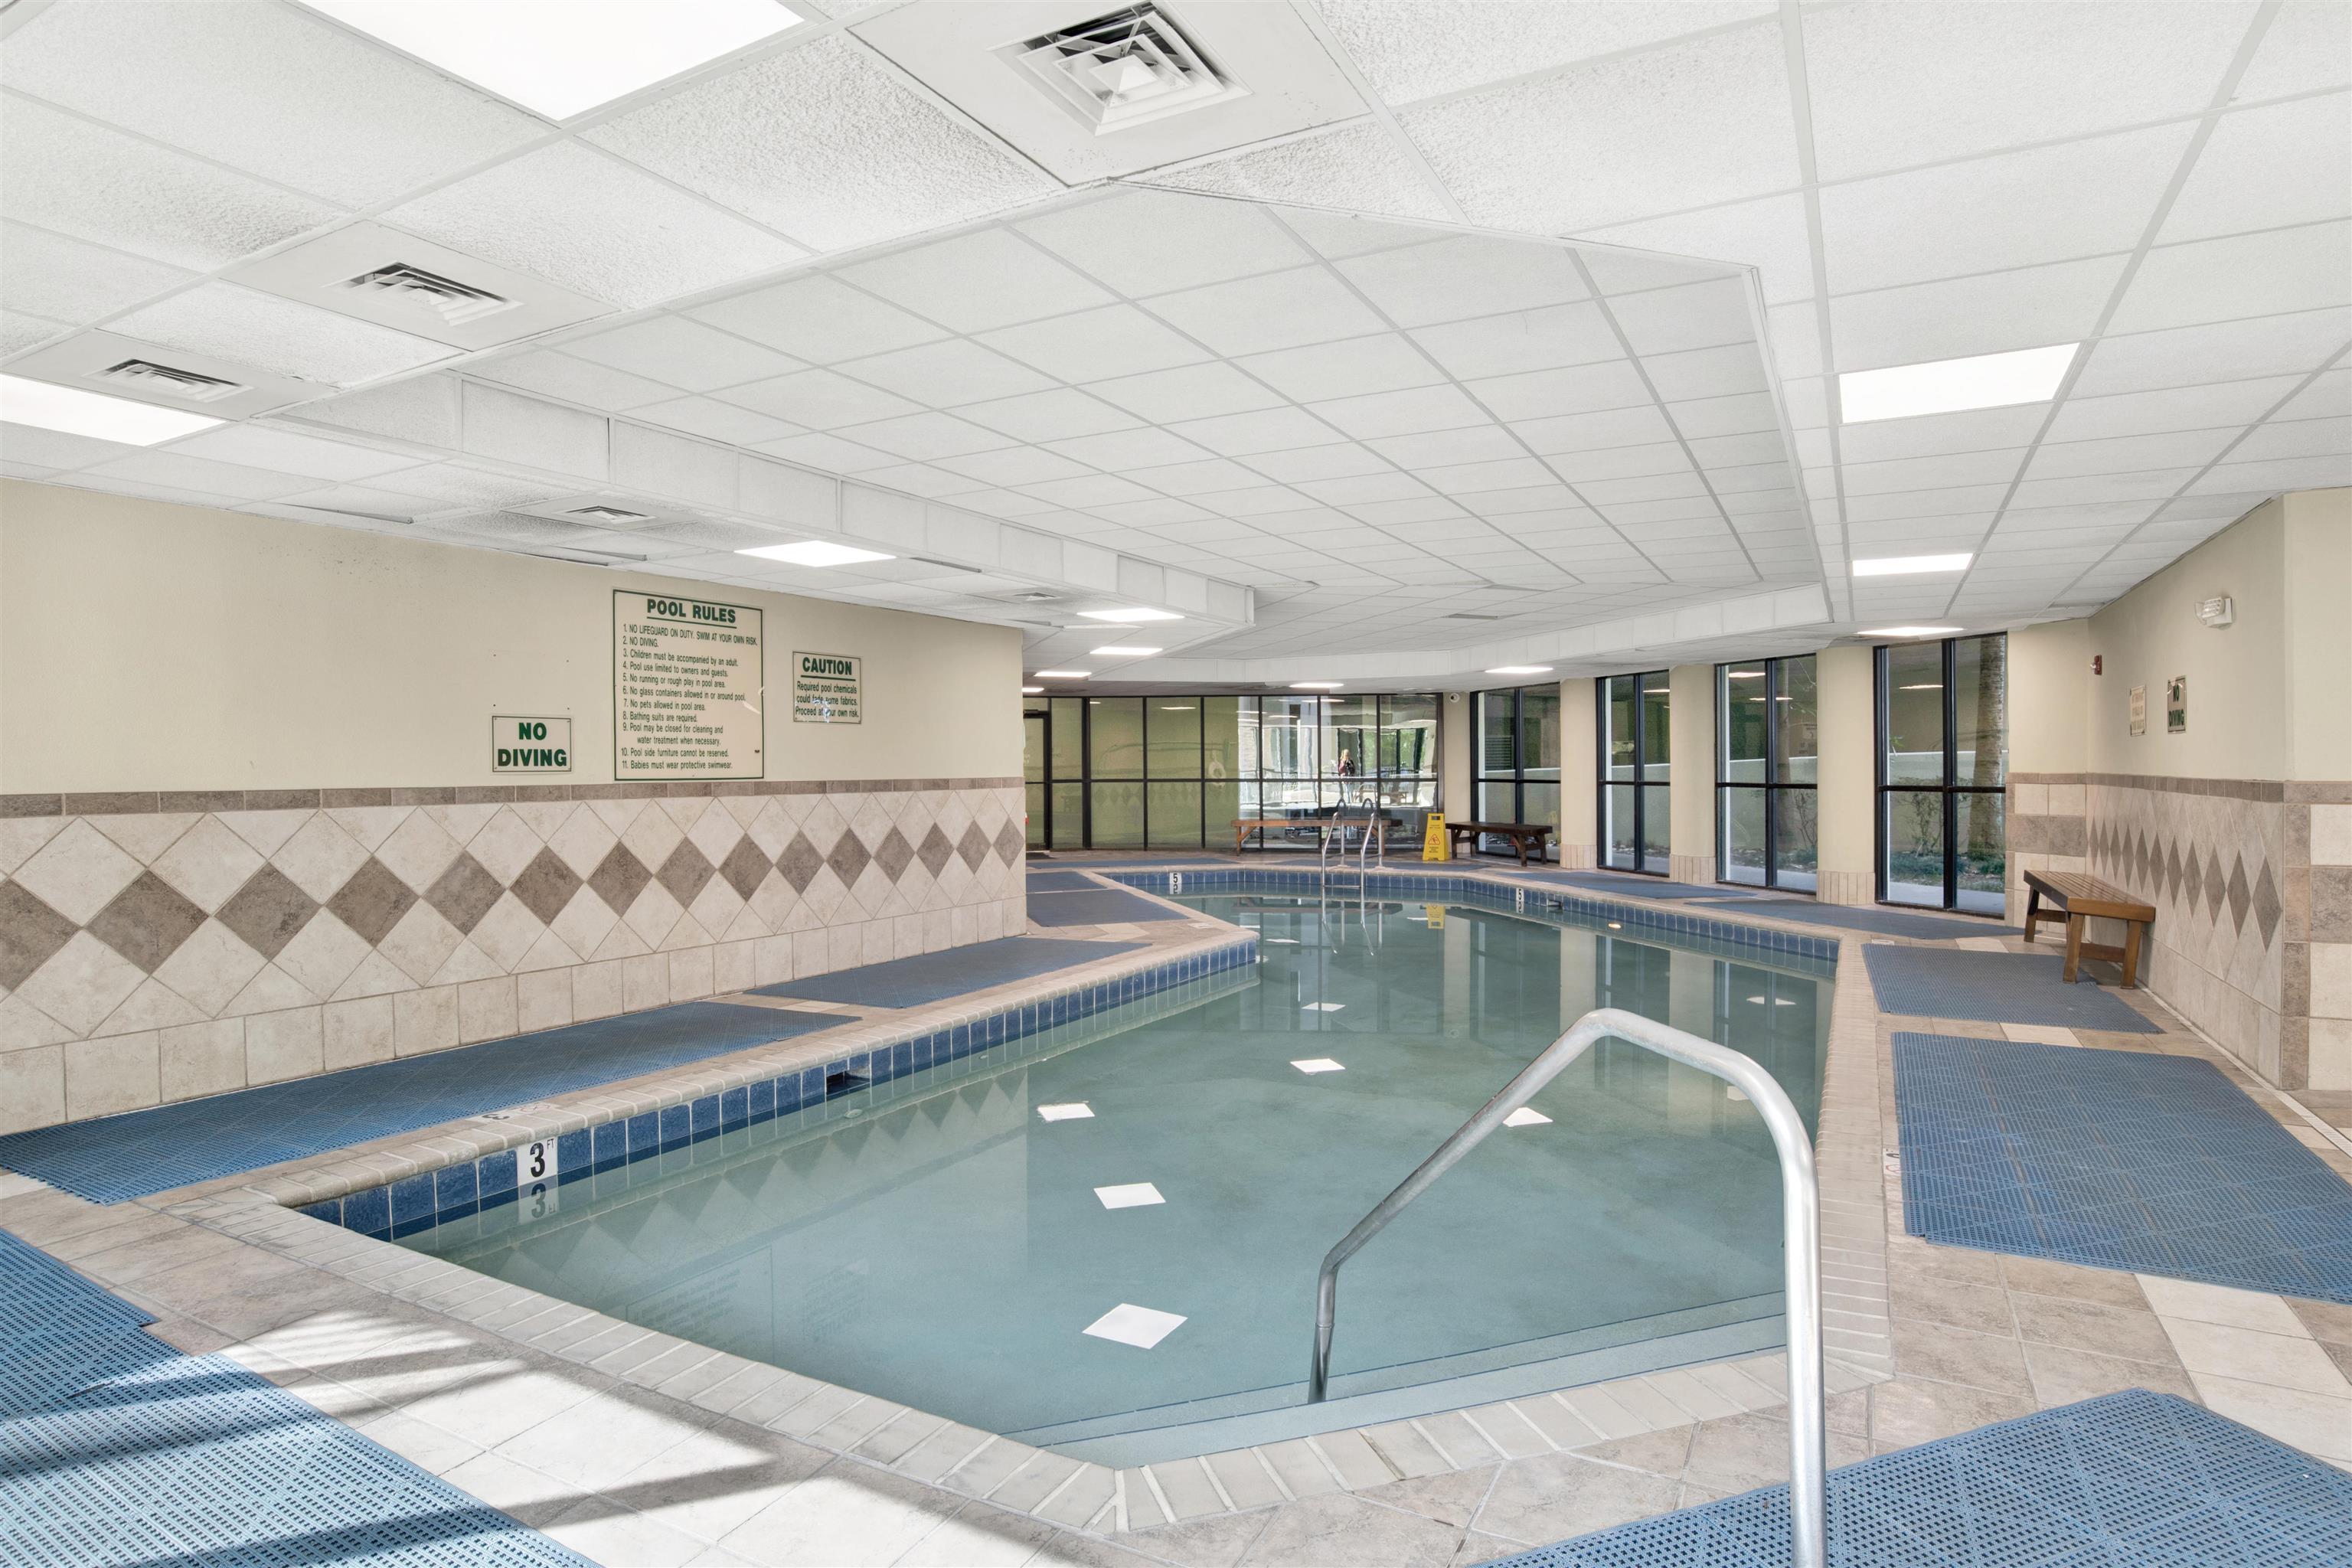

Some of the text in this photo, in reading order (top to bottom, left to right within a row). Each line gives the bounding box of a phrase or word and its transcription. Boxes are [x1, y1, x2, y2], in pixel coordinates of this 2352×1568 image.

[647, 599, 736, 623] POOL RULES
[623, 624, 627, 632] 1.
[629, 624, 637, 634] NO
[639, 626, 668, 636] LIFEGUARD
[671, 629, 678, 638] ON
[680, 630, 694, 639] DUTY.
[697, 632, 710, 640] SWIM
[719, 634, 731, 642] YOUR
[733, 635, 744, 644] OWN
[746, 636, 757, 645] RISK.
[623, 636, 658, 647] 2. NO DIVING.
[623, 648, 628, 657] 3.
[630, 648, 652, 659] Children
[654, 652, 666, 660] must
[668, 652, 675, 661] be
[677, 654, 709, 665] accompanied
[711, 655, 717, 665] by
[726, 657, 738, 666] adult.
[623, 661, 628, 669] 4.
[630, 662, 642, 671] Pool
[655, 664, 672, 673] limited
[701, 667, 709, 675] and
[711, 668, 728, 678] guests.
[802, 657, 852, 675] CAUTION
[623, 673, 628, 681] 5.
[630, 673, 637, 682] No
[639, 675, 658, 685] running
[668, 677, 681, 688] rough
[684, 678, 694, 688] play
[702, 678, 712, 688] pool
[623, 686, 628, 694] 6.
[630, 687, 637, 695] No
[639, 688, 653, 697] glass
[656, 688, 682, 697] containers
[684, 688, 702, 698] allowed
[704, 690, 708, 698] in
[717, 691, 733, 700] around
[735, 692, 746, 701] pool.
[797, 681, 857, 694] Required pool chemicals
[2173, 684, 2180, 702] NO
[624, 698, 629, 707] 7.
[630, 699, 637, 707] No
[640, 701, 652, 710] pets
[654, 701, 672, 709] allowed
[681, 702, 692, 710] pool
[797, 694, 810, 703] could
[841, 697, 858, 705] fabrics.
[623, 710, 628, 720] 8.
[630, 711, 649, 722] Bathing
[652, 712, 664, 721] suits
[677, 714, 697, 723] required.
[795, 706, 816, 716] Proceed
[849, 708, 858, 717] risk.
[519, 723, 547, 740] NO
[623, 723, 628, 731] 9.
[630, 723, 642, 731] Pool
[644, 725, 654, 733] may
[665, 724, 681, 733] closed
[693, 725, 712, 735] cleaning
[637, 735, 652, 744] water
[695, 738, 720, 746] necessary.
[498, 749, 567, 766] DIVING
[631, 748, 642, 756] Pool
[645, 748, 655, 756] side
[658, 748, 678, 757] furniture
[631, 760, 648, 769] Babies
[681, 761, 706, 769] protective
[708, 761, 732, 769] swimwear.
[1173, 873, 1178, 884] 5
[1518, 888, 1522, 900] 5
[530, 1138, 554, 1178] 3 FT
